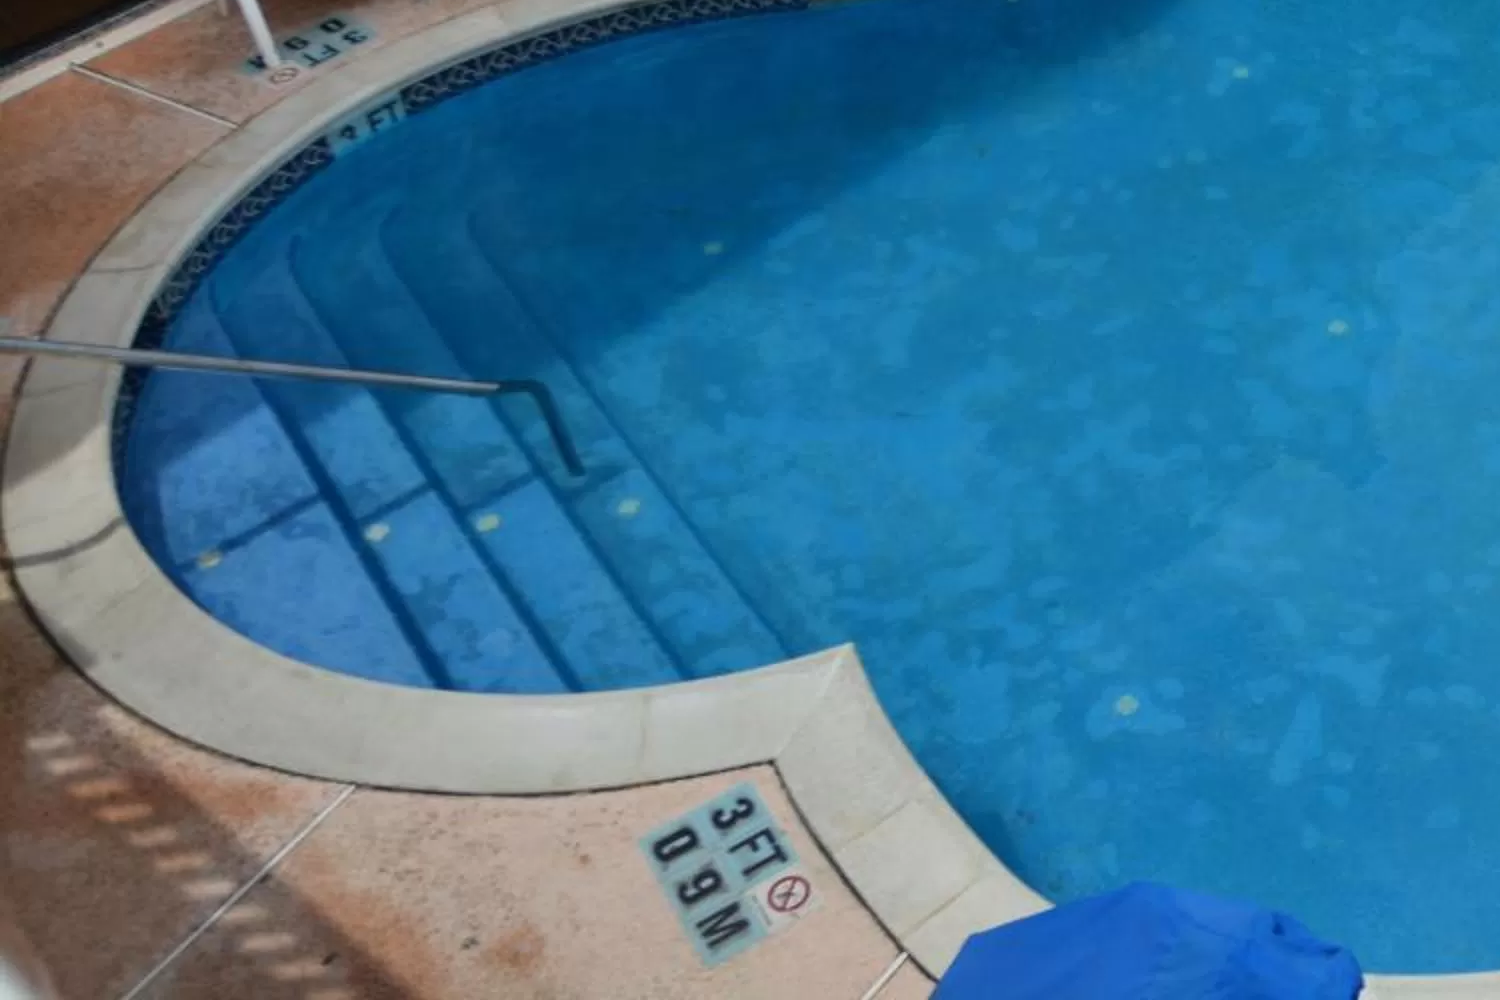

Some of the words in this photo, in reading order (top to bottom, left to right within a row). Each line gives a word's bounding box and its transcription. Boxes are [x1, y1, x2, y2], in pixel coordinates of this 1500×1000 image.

[711, 797, 755, 830] 3
[727, 827, 788, 877] FT
[695, 901, 750, 949] M
